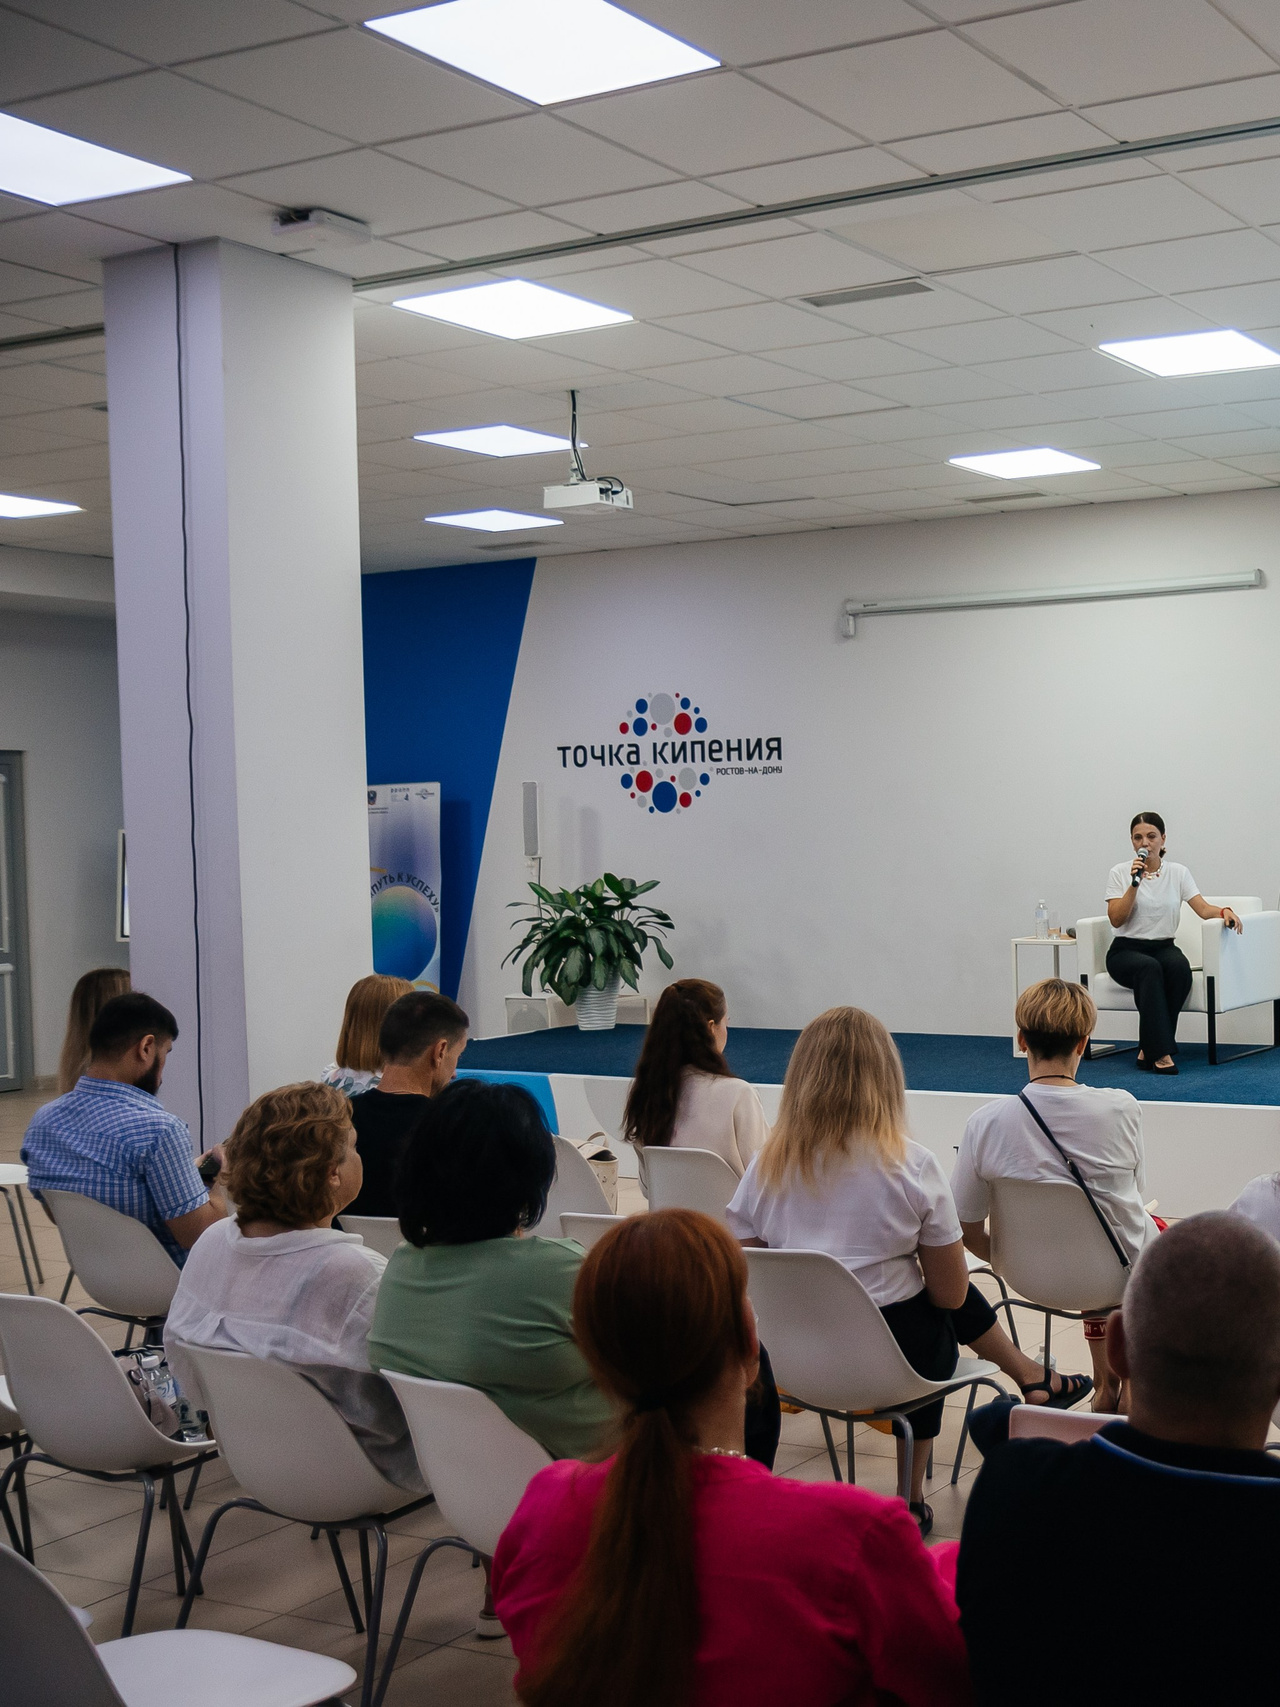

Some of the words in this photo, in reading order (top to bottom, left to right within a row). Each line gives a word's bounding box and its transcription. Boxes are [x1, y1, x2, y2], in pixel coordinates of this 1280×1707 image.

[556, 743, 641, 768] точка
[652, 737, 783, 765] кипения
[716, 765, 783, 776] РОСТОВ-НА-ДОНУ
